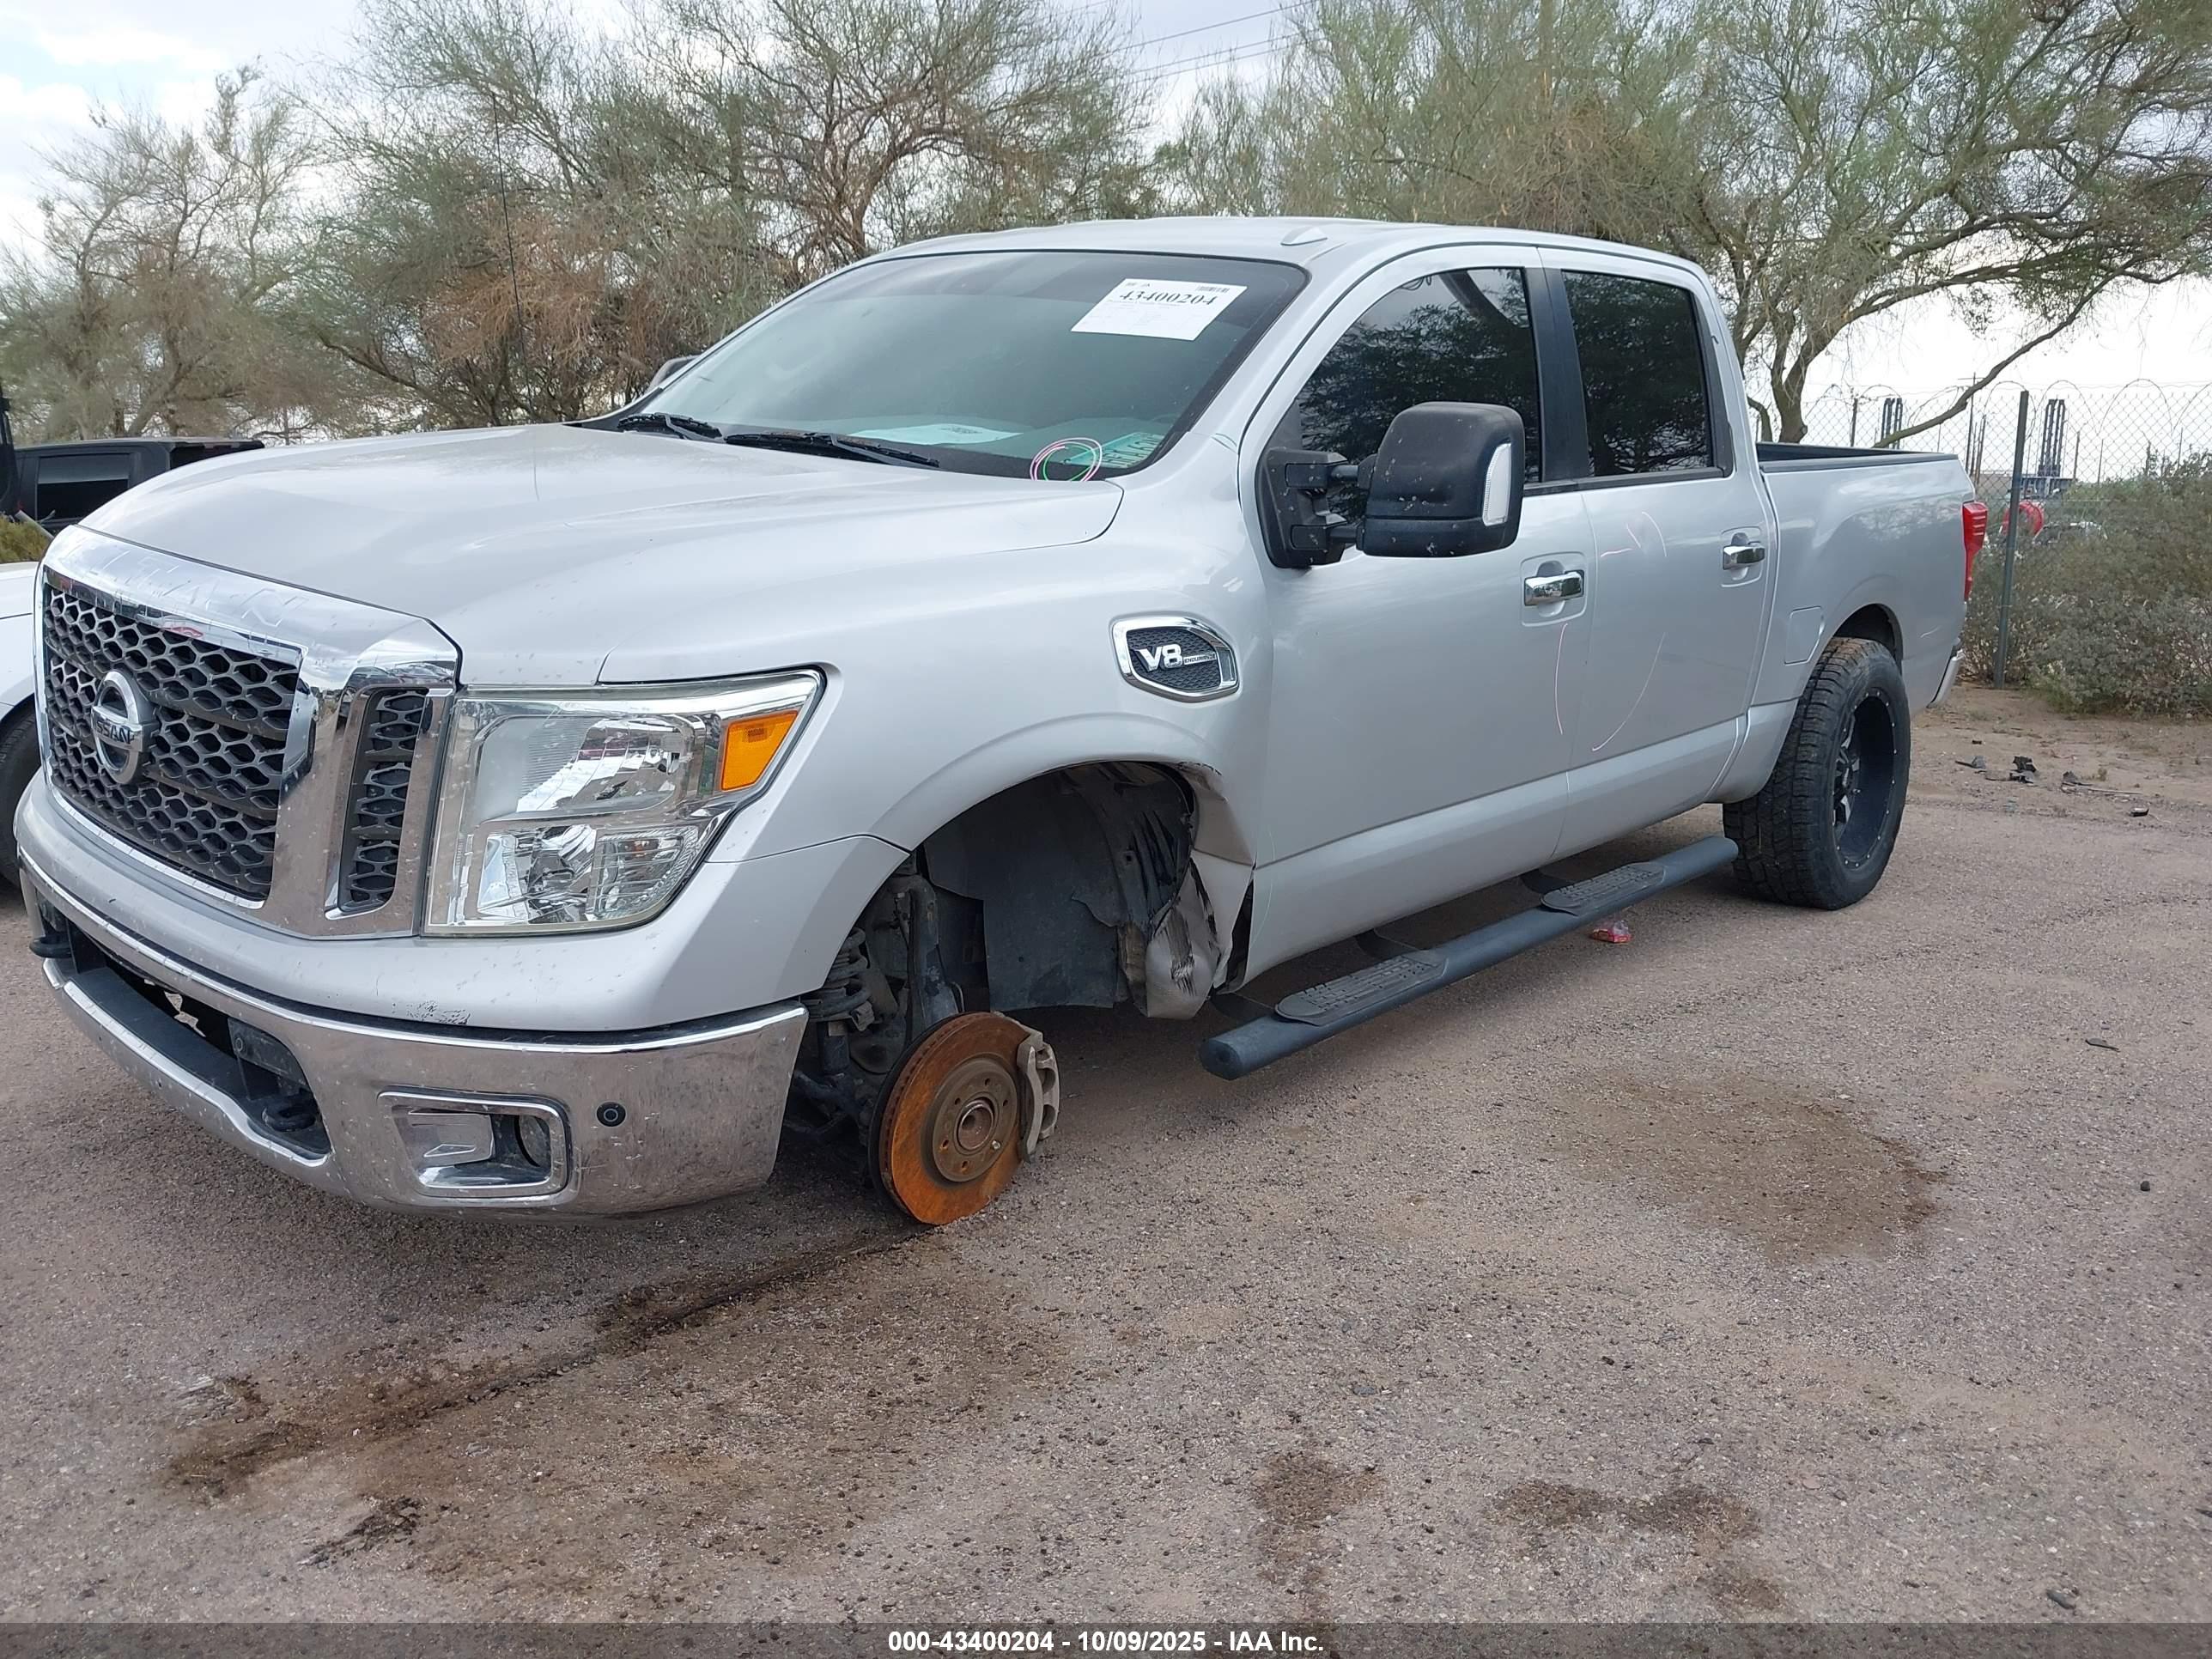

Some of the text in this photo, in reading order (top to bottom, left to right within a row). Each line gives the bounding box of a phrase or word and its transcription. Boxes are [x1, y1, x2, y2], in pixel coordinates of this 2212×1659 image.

[1120, 290, 1218, 305] 43400204
[1134, 643, 1183, 672] V8
[93, 718, 131, 744] SSAN
